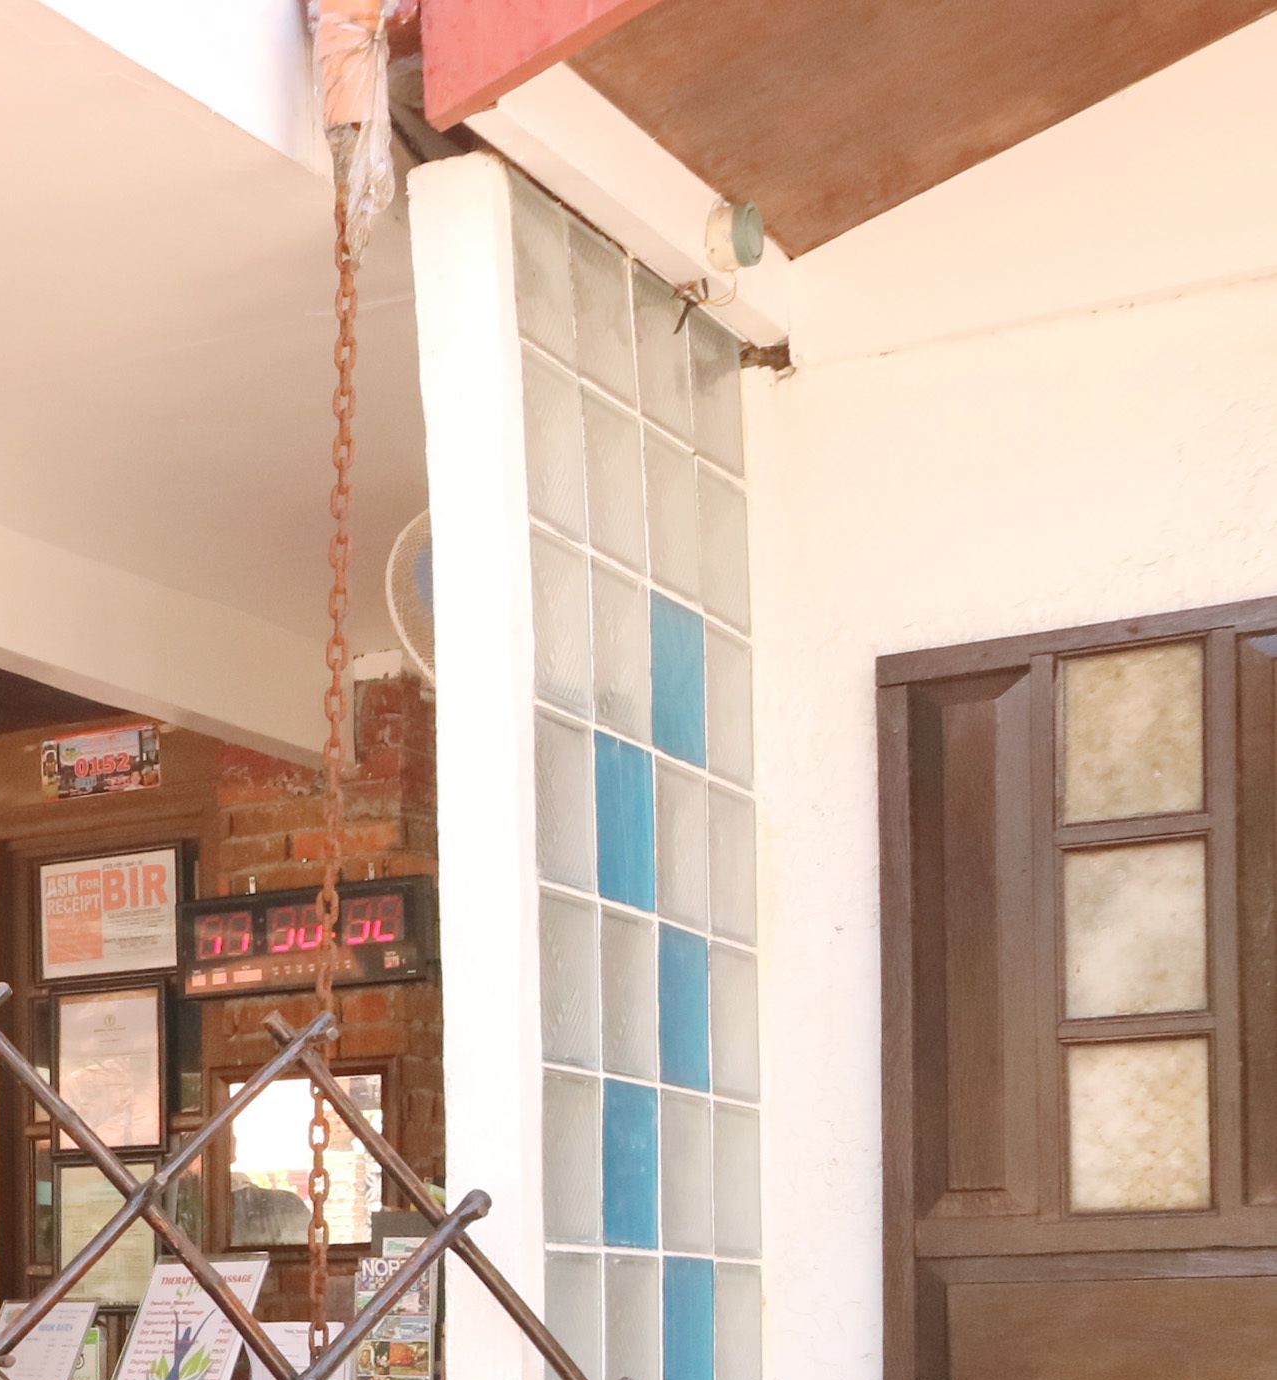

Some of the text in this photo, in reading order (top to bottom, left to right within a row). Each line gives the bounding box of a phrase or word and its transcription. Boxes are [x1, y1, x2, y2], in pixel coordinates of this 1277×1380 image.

[74, 752, 131, 778] 0152
[46, 873, 100, 897] ASK FOR
[102, 864, 168, 912] BIR
[46, 894, 101, 916] RECEIPT
[220, 1273, 253, 1283] ASSAGE
